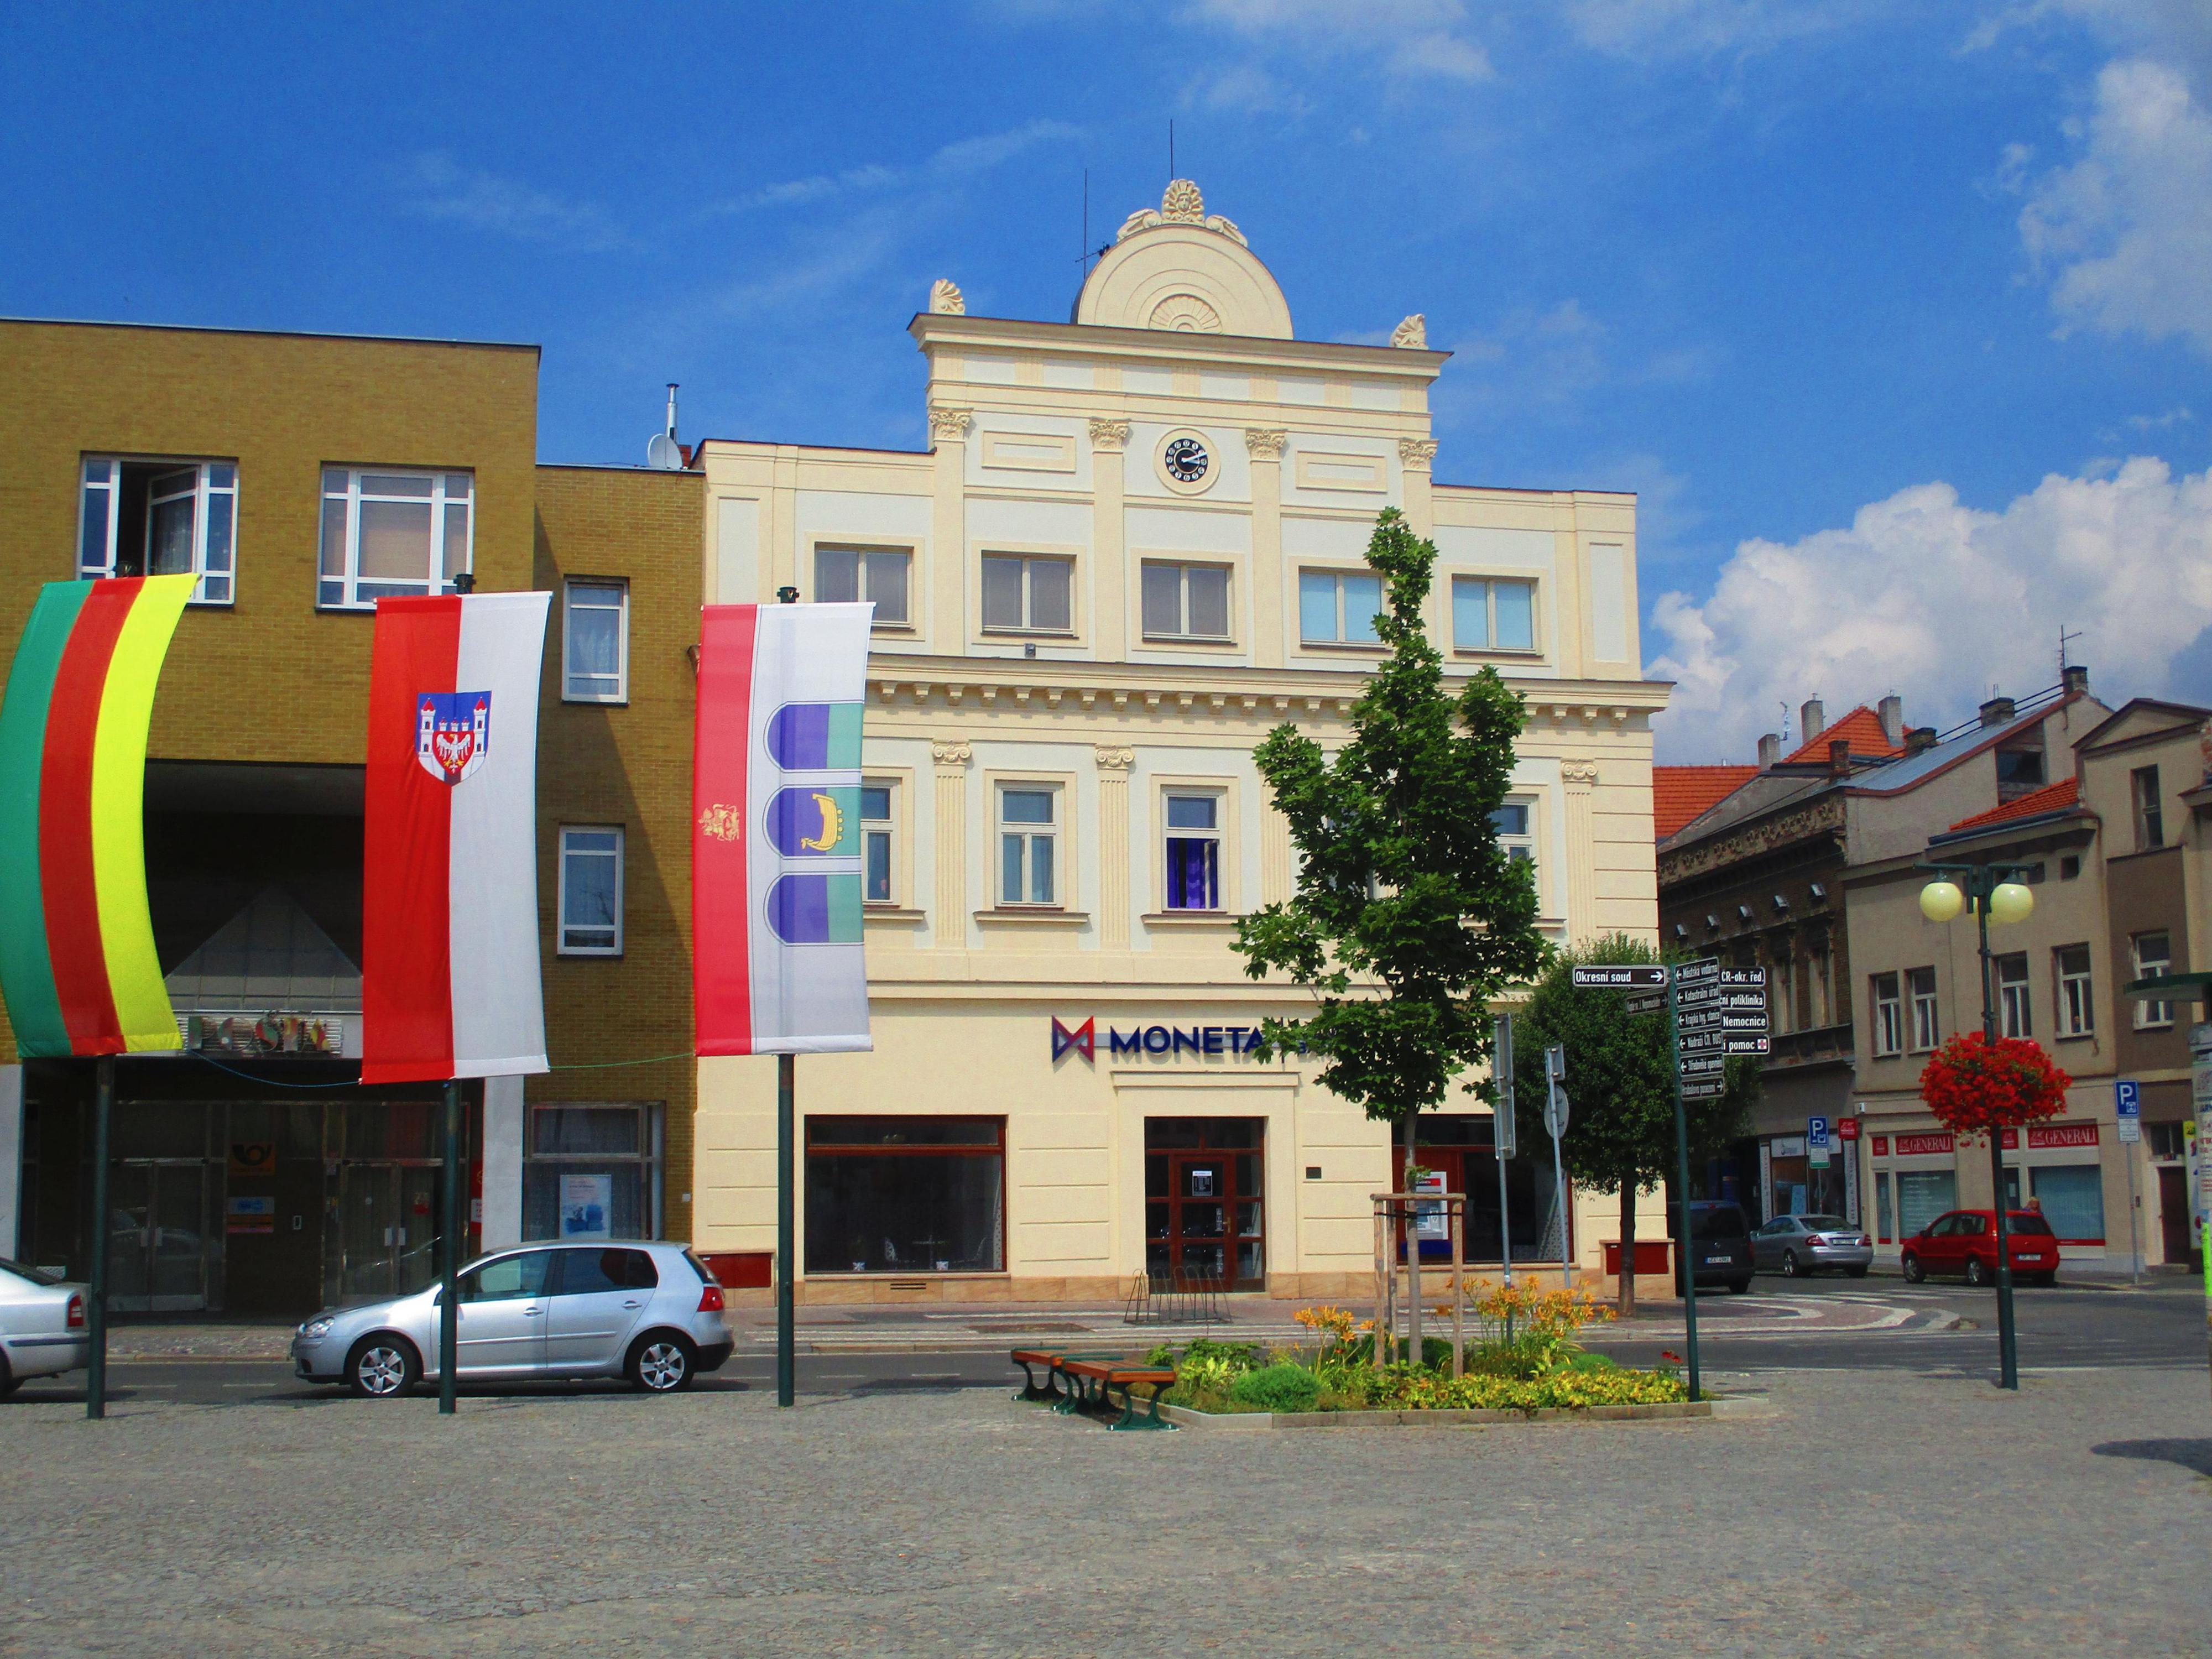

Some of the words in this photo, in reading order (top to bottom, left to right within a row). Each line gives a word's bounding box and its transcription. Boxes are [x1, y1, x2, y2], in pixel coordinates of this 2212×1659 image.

[1575, 971, 1609, 983] Okresní
[1611, 971, 1631, 983] soud
[1721, 969, 1748, 982] ČR-okr.
[1750, 971, 1764, 982] řed.
[1730, 994, 1763, 1008] poliklinika
[1707, 1009, 1720, 1021] stanice
[1723, 1015, 1766, 1027] Nemocnice
[1110, 1025, 1265, 1054] MONETA
[1687, 1034, 1704, 1048] Nádraží
[1729, 1041, 1755, 1053] pomoc
[2119, 1084, 2133, 1105] P
[1812, 1120, 1824, 1137] P
[2046, 1128, 2096, 1145] GENERALI
[1910, 1136, 1951, 1152] GENERALI
